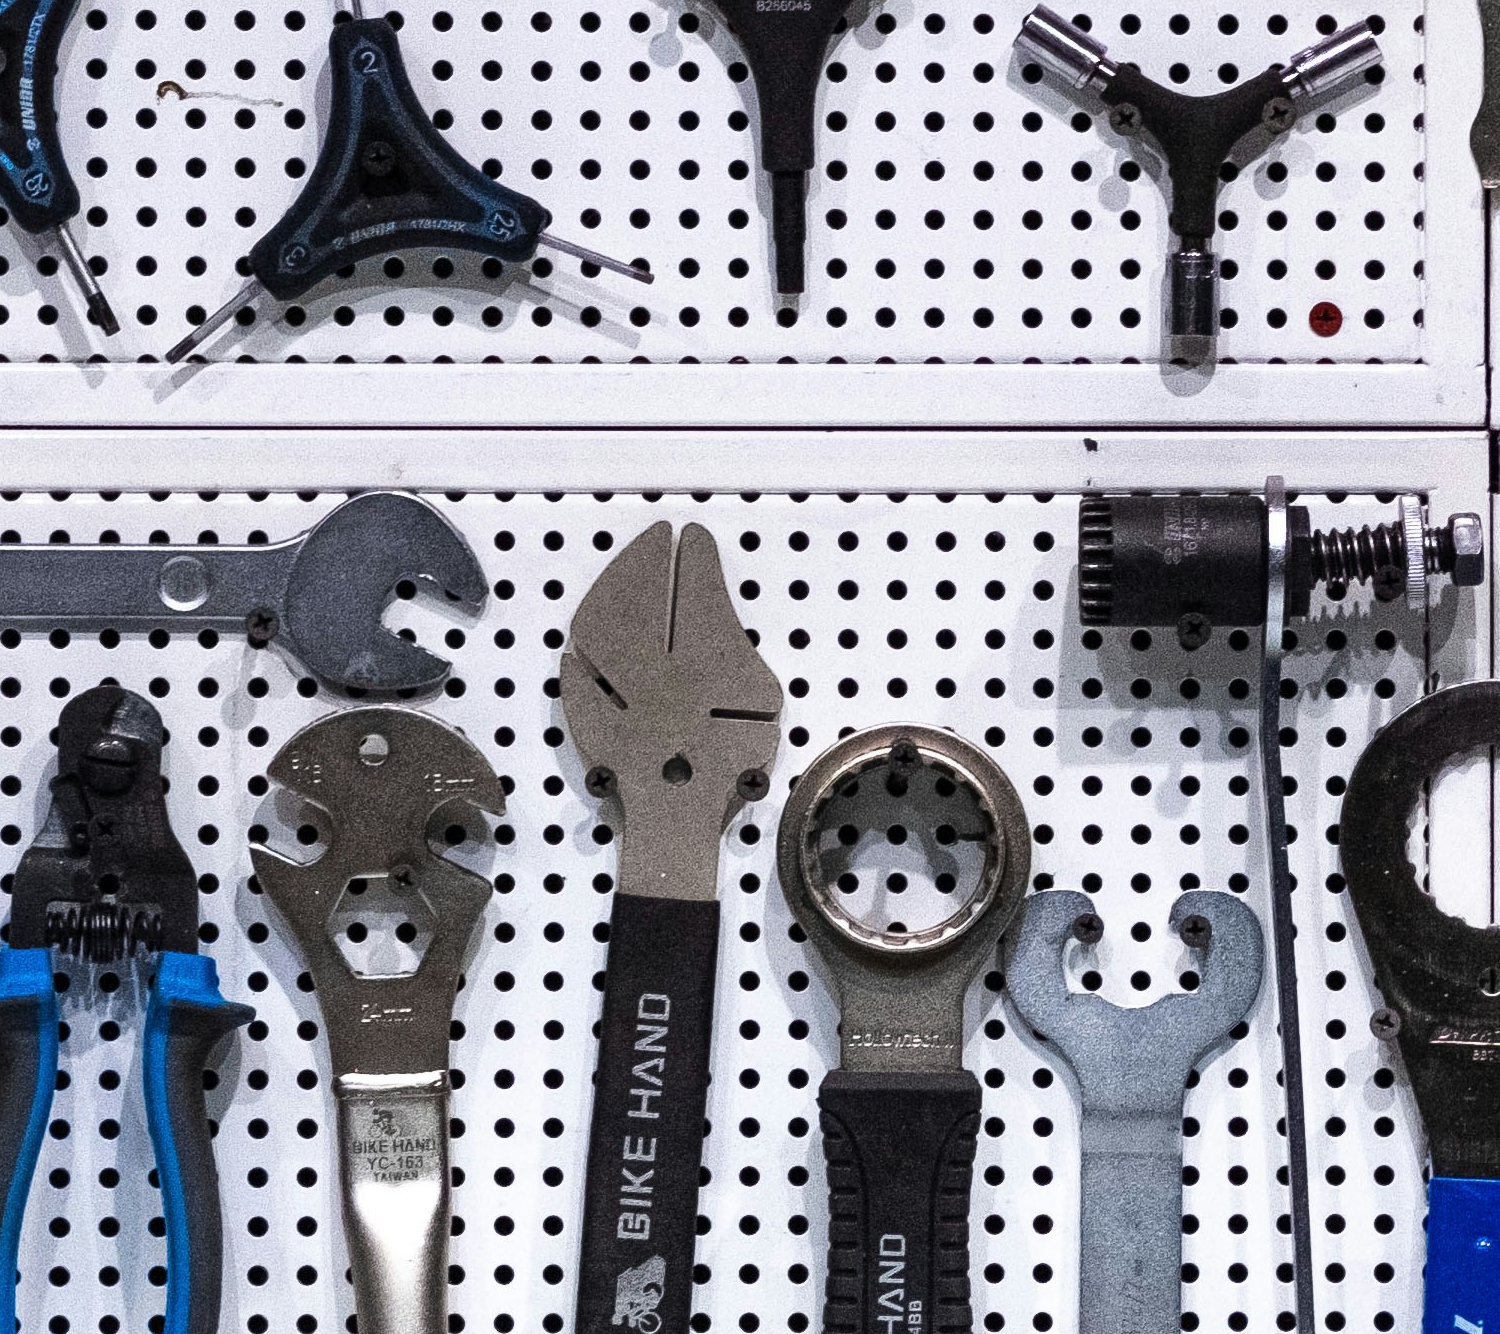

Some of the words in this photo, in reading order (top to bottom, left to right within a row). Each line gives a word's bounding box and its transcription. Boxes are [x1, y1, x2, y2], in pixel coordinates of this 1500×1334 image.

[360, 50, 380, 74] 2
[627, 993, 672, 1120] HAND
[350, 1140, 390, 1155] BIKE
[617, 1136, 657, 1241] BIKE
